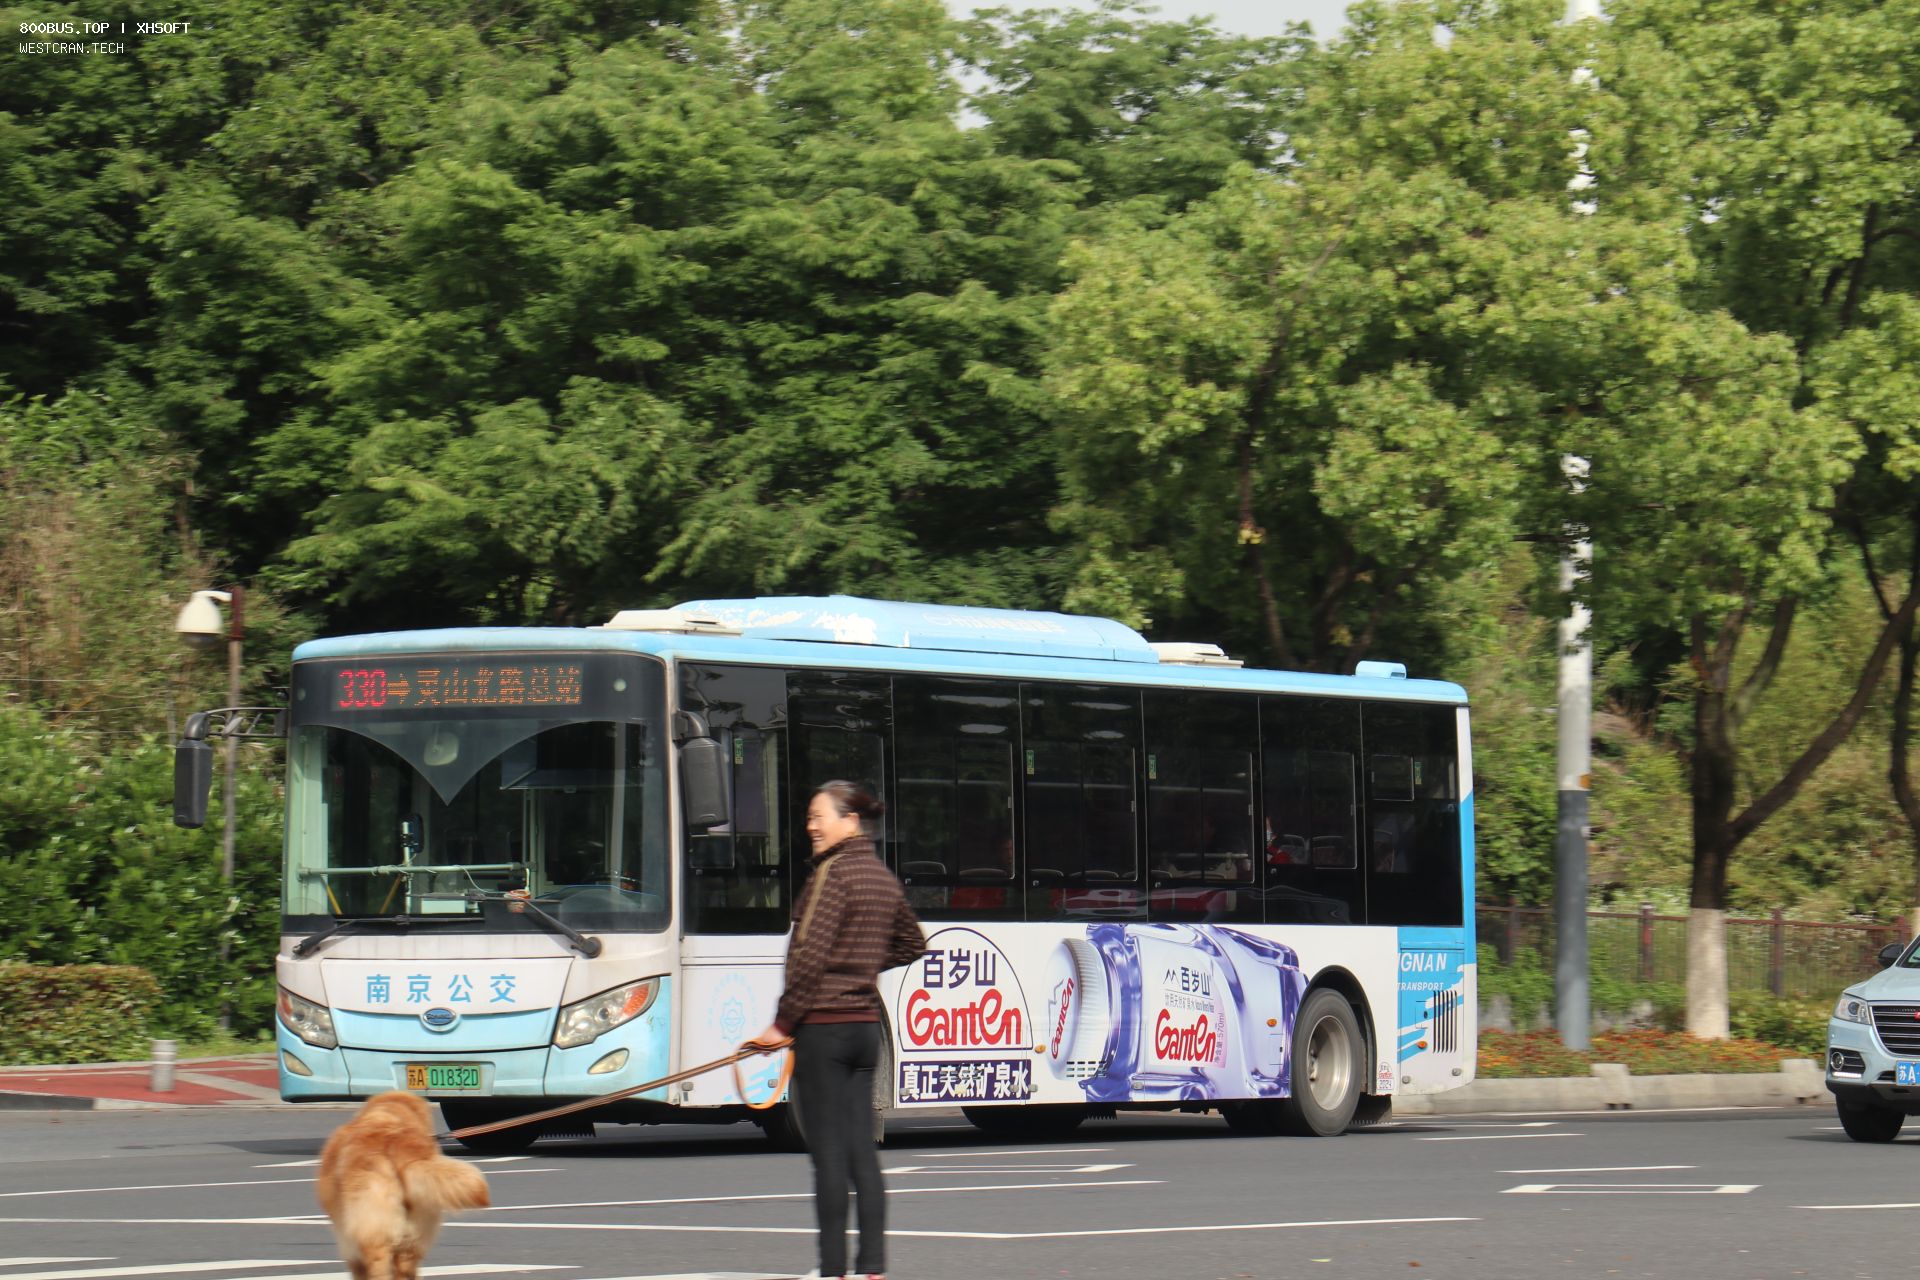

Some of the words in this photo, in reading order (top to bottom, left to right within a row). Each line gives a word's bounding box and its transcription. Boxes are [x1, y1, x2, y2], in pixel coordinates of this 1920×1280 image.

[338, 668, 387, 708] 330
[414, 666, 581, 706] 灵山北路总站
[365, 973, 517, 1004] 南京公交
[922, 948, 997, 989] 百岁山
[1181, 967, 1210, 996] 百岁山
[905, 988, 1022, 1047] Ganten
[1155, 1008, 1217, 1063] Ganten
[901, 1062, 1030, 1102] 真正天然矿泉水
